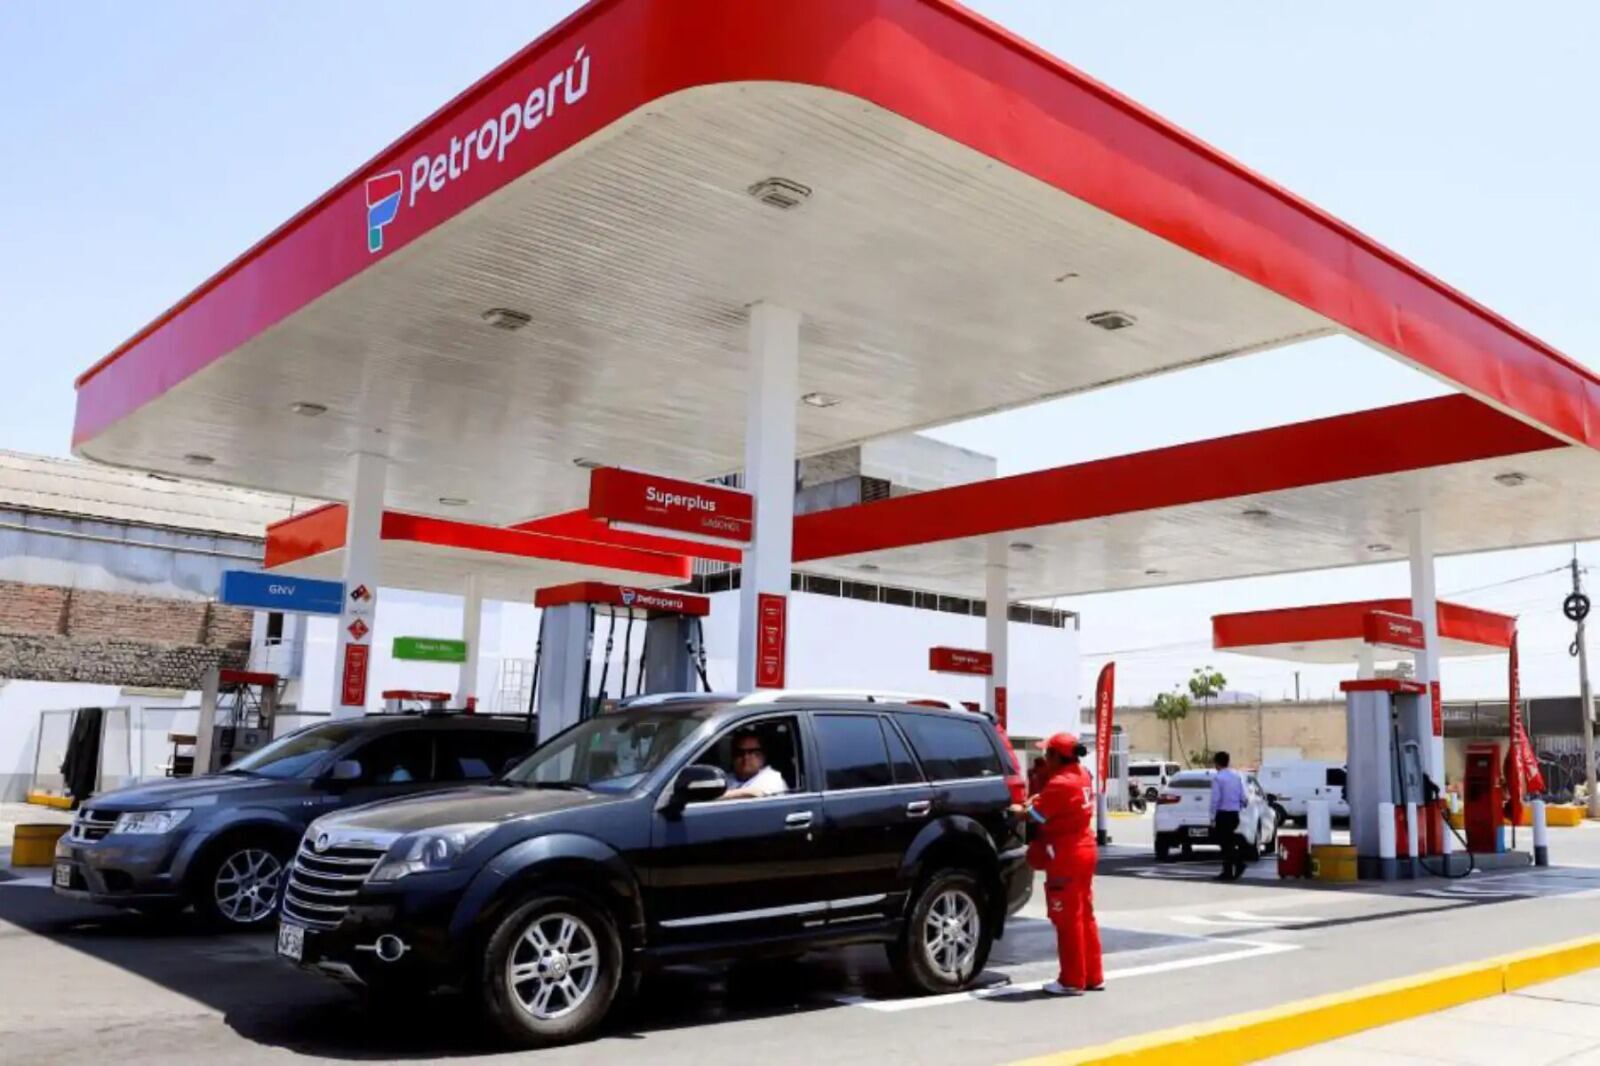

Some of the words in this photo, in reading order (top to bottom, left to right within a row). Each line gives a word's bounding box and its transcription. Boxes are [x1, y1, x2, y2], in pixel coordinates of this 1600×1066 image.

[409, 44, 590, 207] Petroperú
[646, 486, 716, 511] Superplus
[269, 584, 296, 596] GNV
